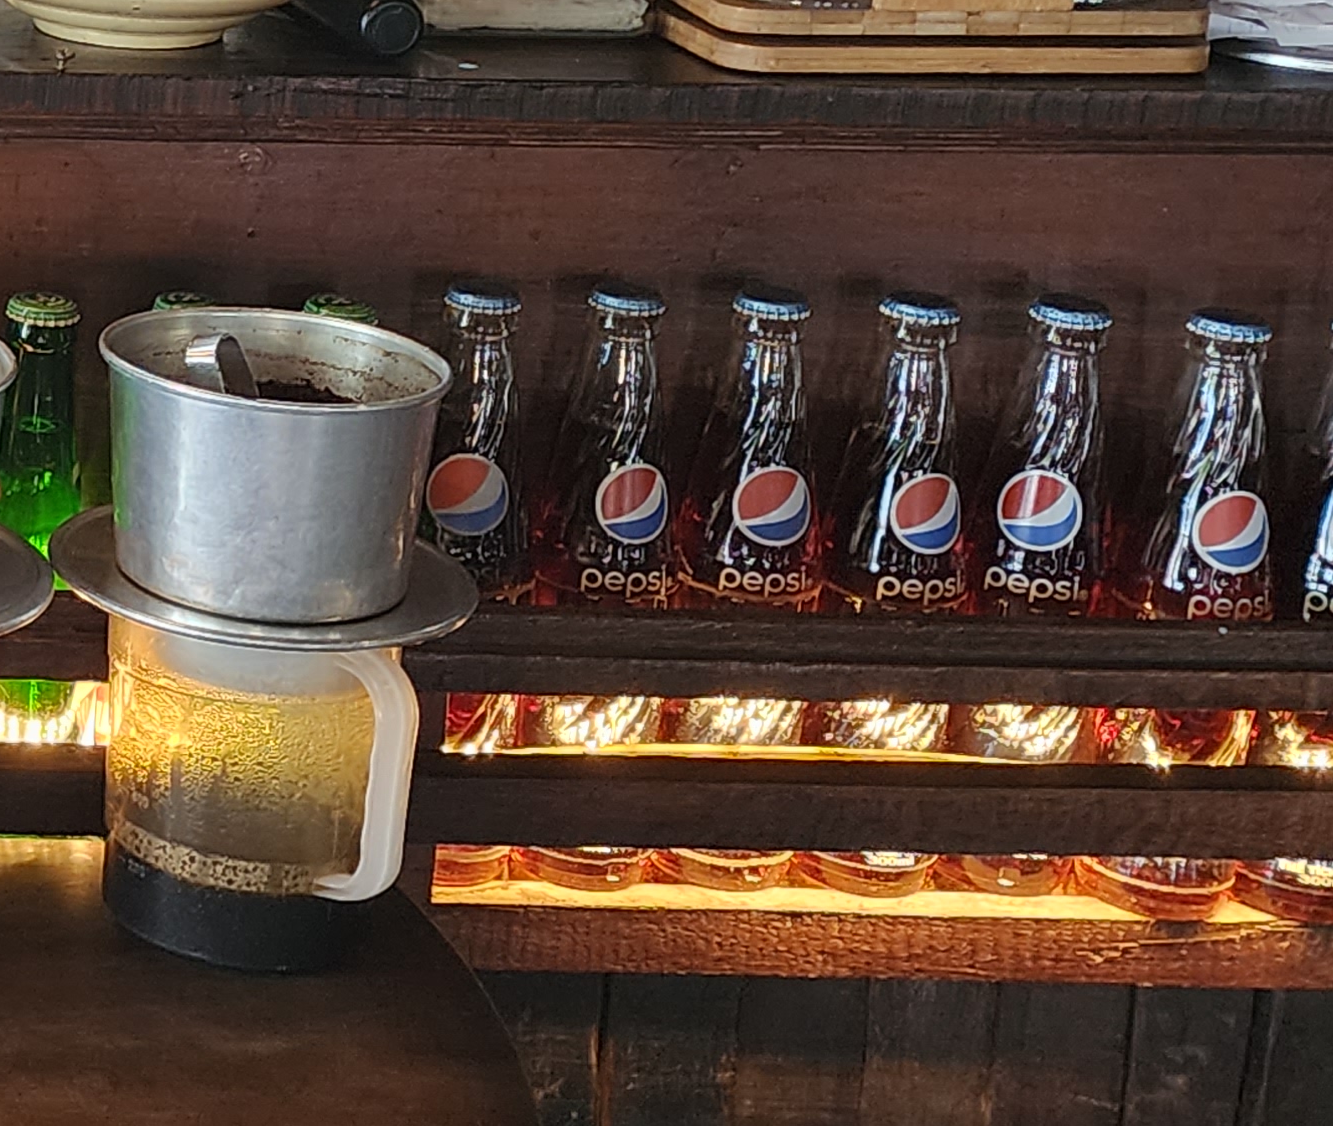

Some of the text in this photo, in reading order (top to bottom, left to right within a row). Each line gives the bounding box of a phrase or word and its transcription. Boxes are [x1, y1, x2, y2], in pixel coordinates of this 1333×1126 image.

[580, 566, 667, 597] pepsi
[719, 566, 807, 597] pepsi
[876, 570, 963, 606] pepsi
[984, 566, 1081, 603] pepsi
